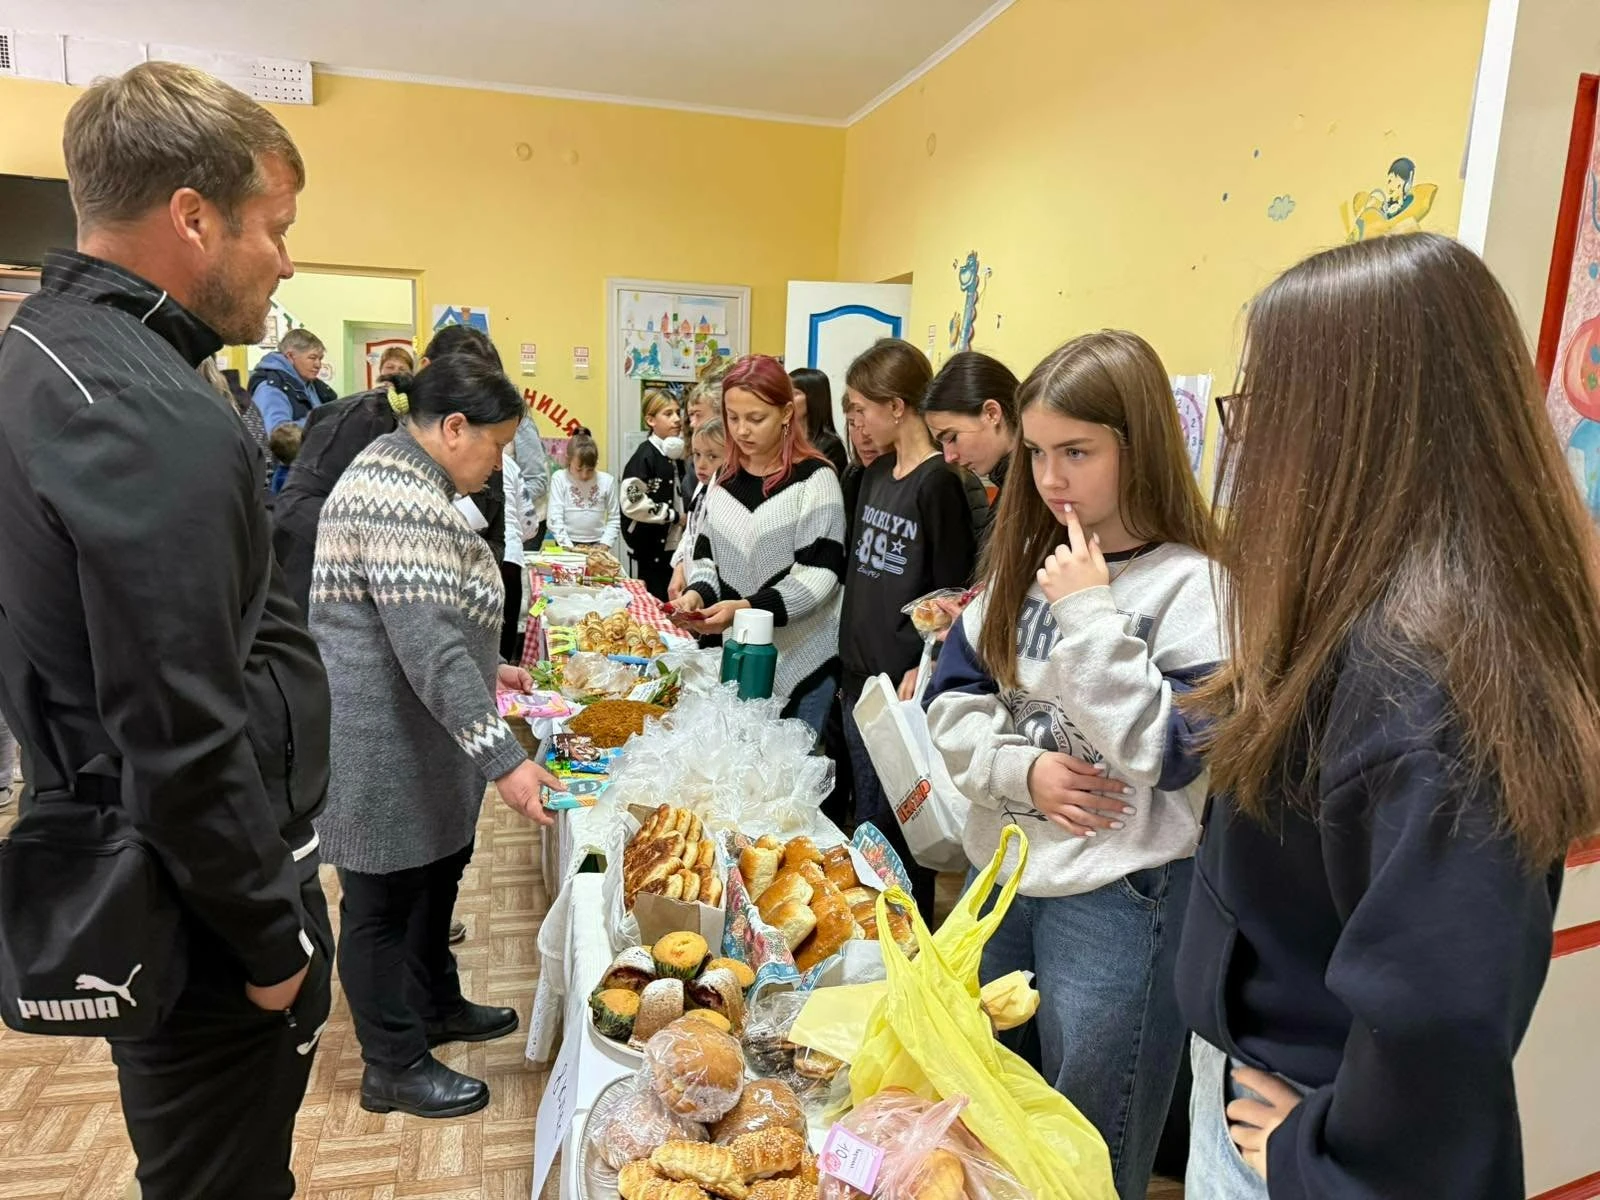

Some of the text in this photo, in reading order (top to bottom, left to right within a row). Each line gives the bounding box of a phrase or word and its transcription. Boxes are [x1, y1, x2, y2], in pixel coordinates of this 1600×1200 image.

[523, 387, 581, 437] НИЦЯ
[1190, 418, 1197, 428] 2
[1191, 436, 1198, 447] 3
[859, 527, 888, 570] 89
[17, 997, 120, 1021] PUMA
[835, 1143, 850, 1159] 10
